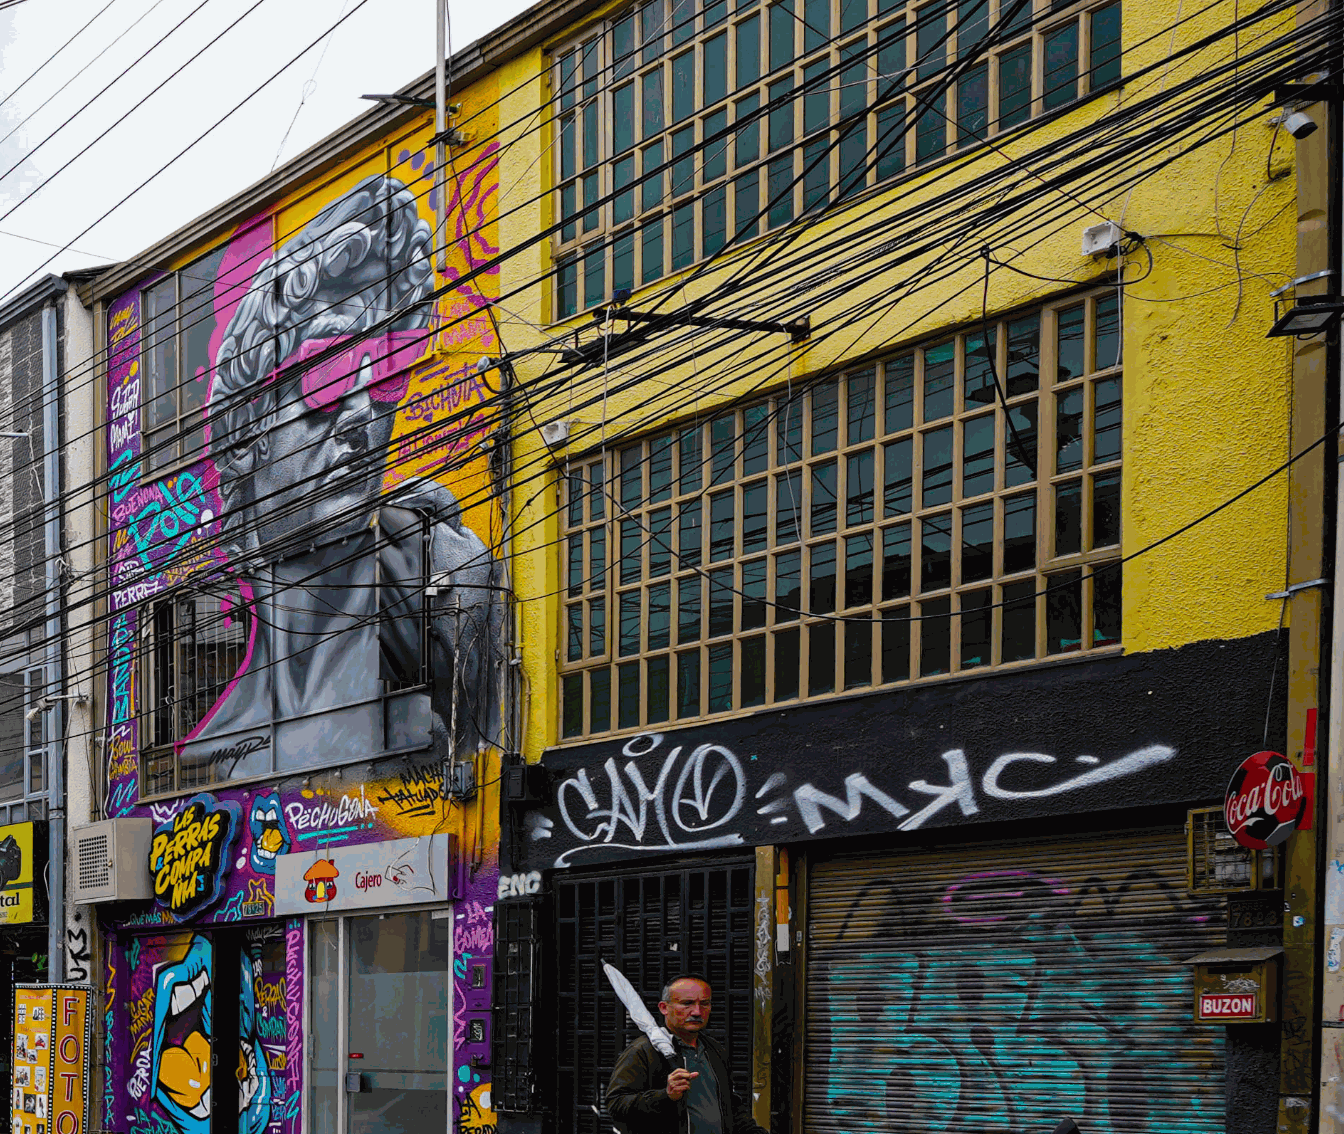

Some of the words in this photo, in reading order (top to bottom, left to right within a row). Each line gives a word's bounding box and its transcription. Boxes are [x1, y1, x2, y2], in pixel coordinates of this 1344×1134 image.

[1226, 762, 1304, 834] Coca-Cola
[174, 806, 196, 833] LAS
[150, 813, 221, 873] PERRAS
[155, 841, 212, 895] COMPA
[355, 871, 382, 893] Cajero
[1202, 998, 1253, 1015] BUZON
